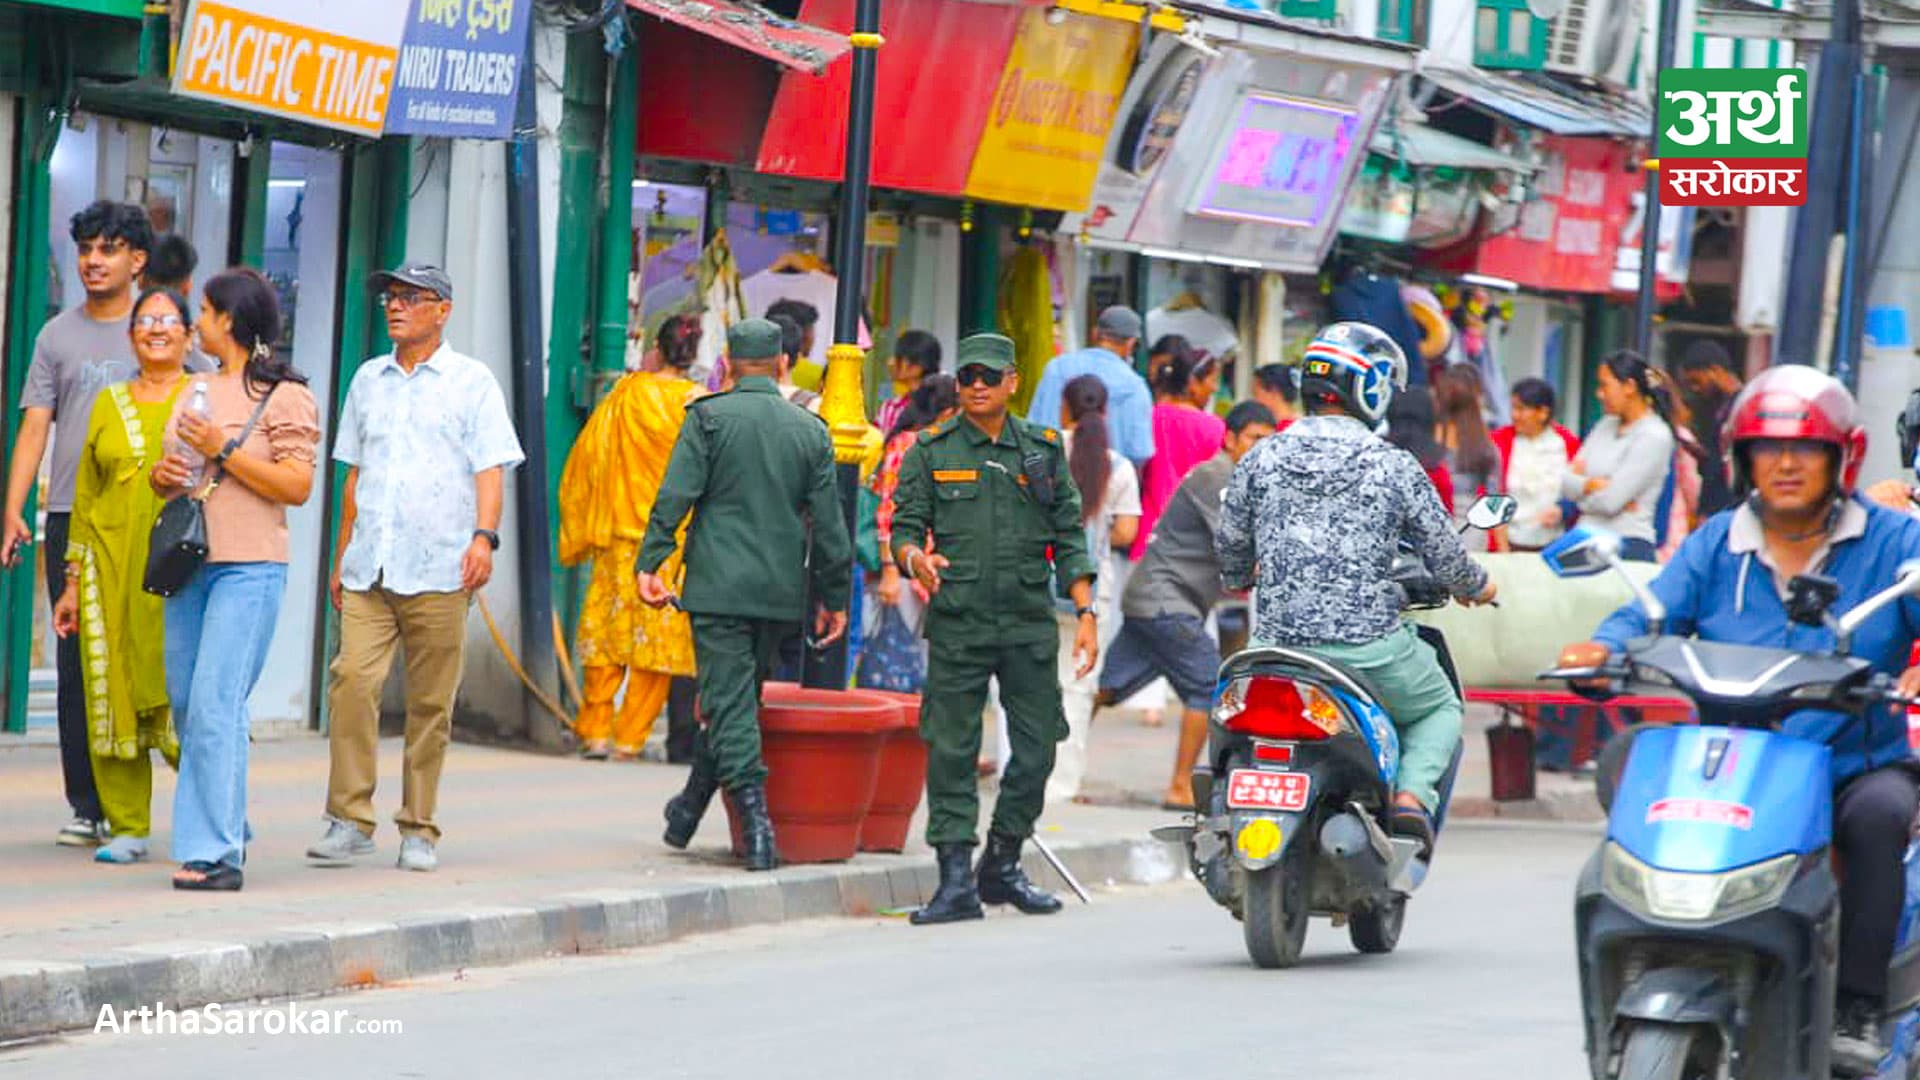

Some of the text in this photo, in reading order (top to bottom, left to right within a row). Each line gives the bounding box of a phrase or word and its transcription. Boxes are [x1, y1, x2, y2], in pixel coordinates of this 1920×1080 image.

[187, 14, 392, 122] PACIFIC TIME
[398, 44, 516, 96] NIRU TRADERS
